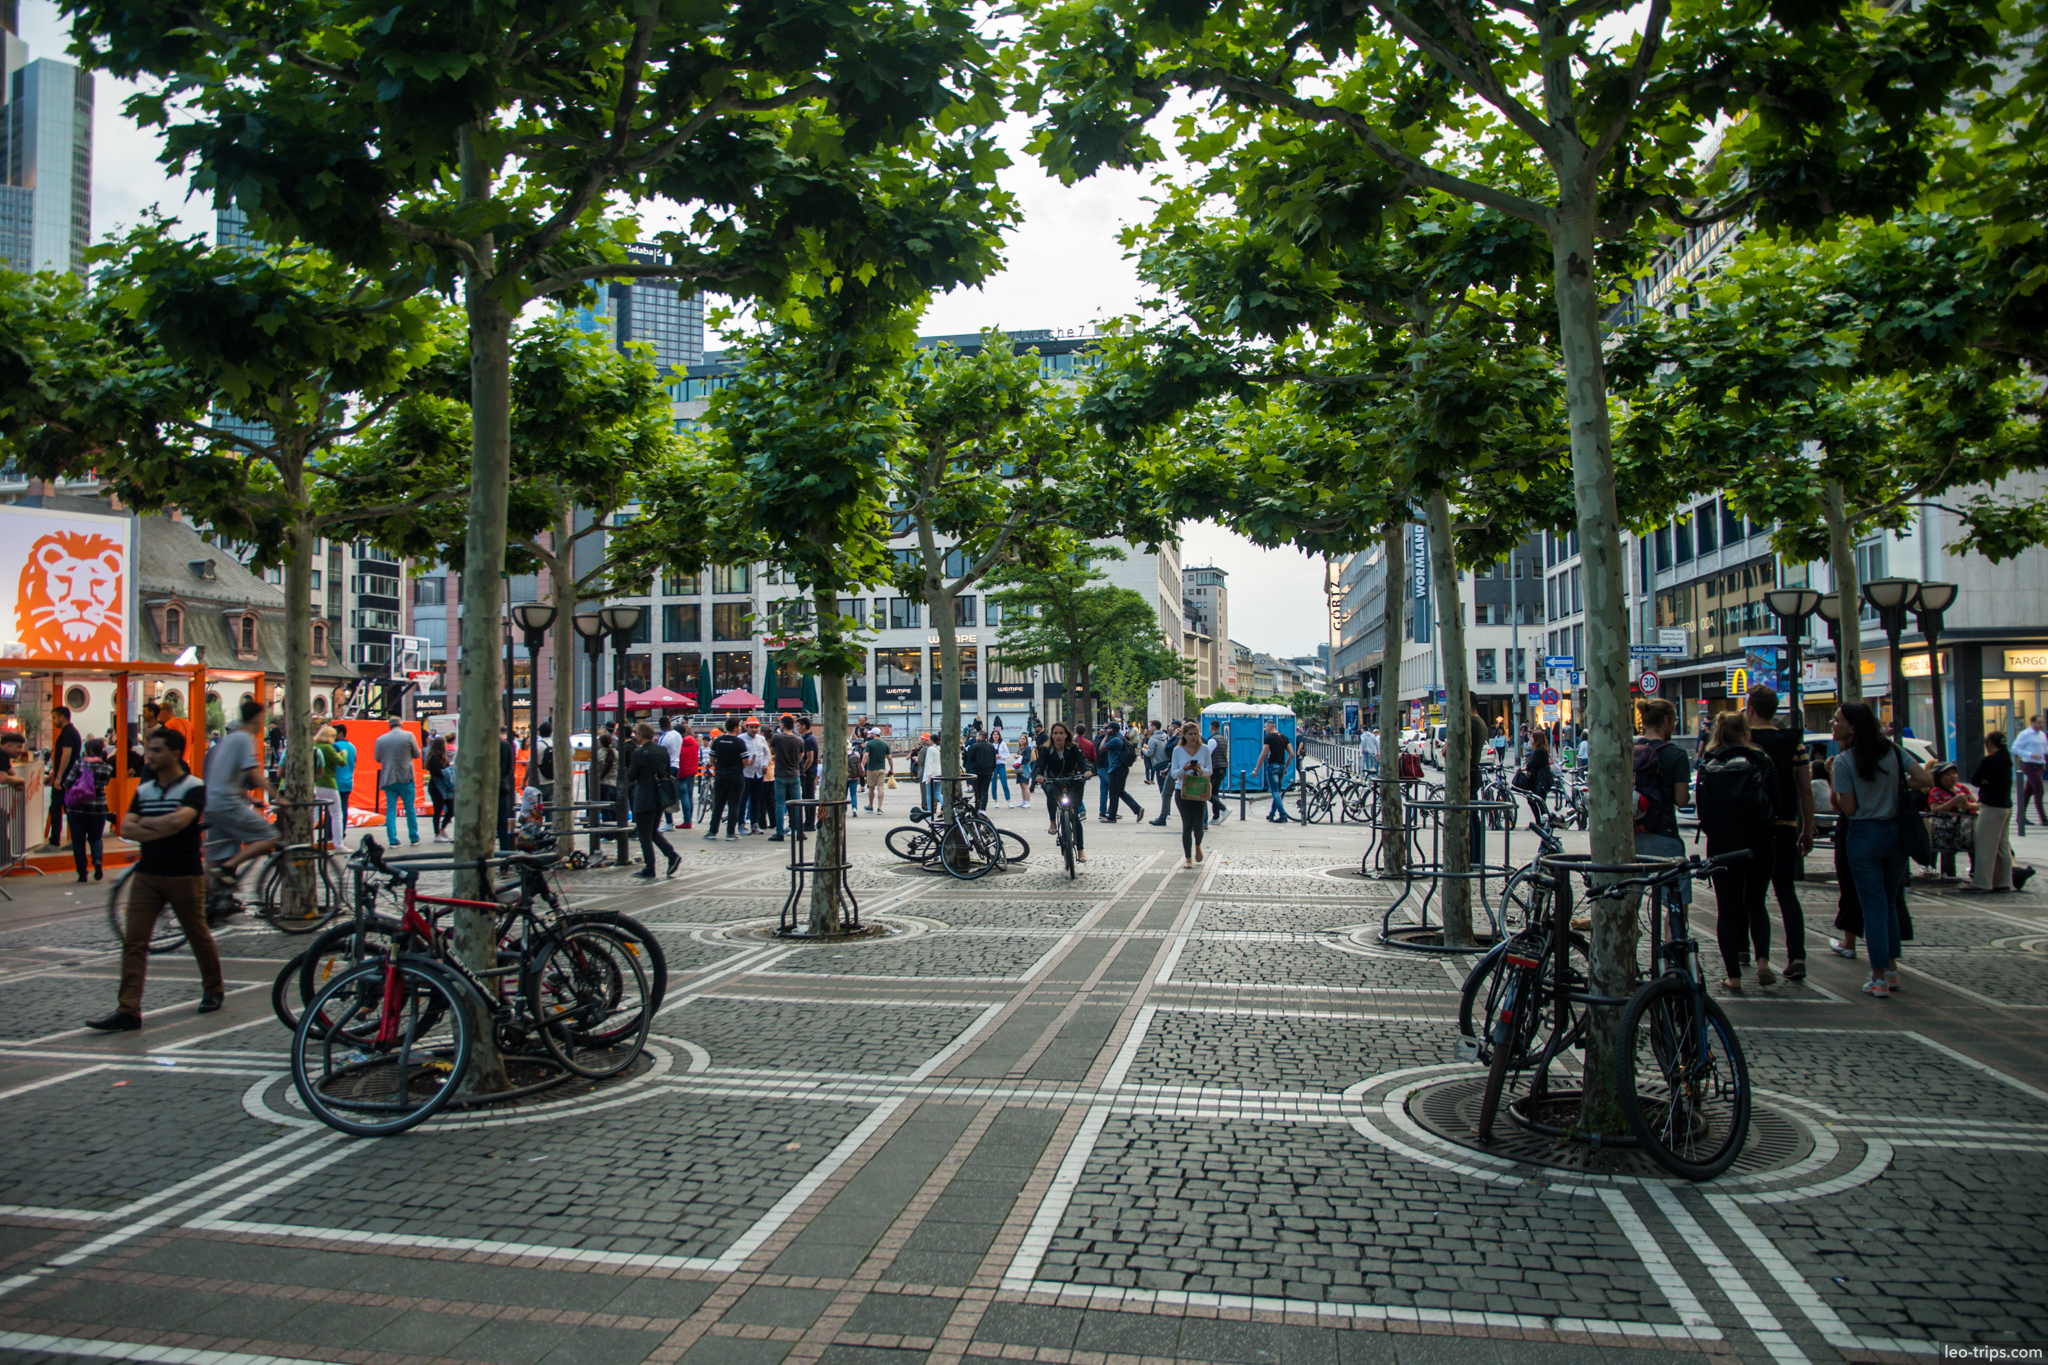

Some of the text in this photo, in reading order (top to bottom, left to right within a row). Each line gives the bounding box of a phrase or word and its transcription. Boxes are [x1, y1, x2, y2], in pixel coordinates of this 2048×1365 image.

[1415, 525, 1427, 599] WORMLAND
[1752, 602, 1771, 618] JONE
[2008, 656, 2047, 666] TARGO
[1643, 677, 1655, 688] 30
